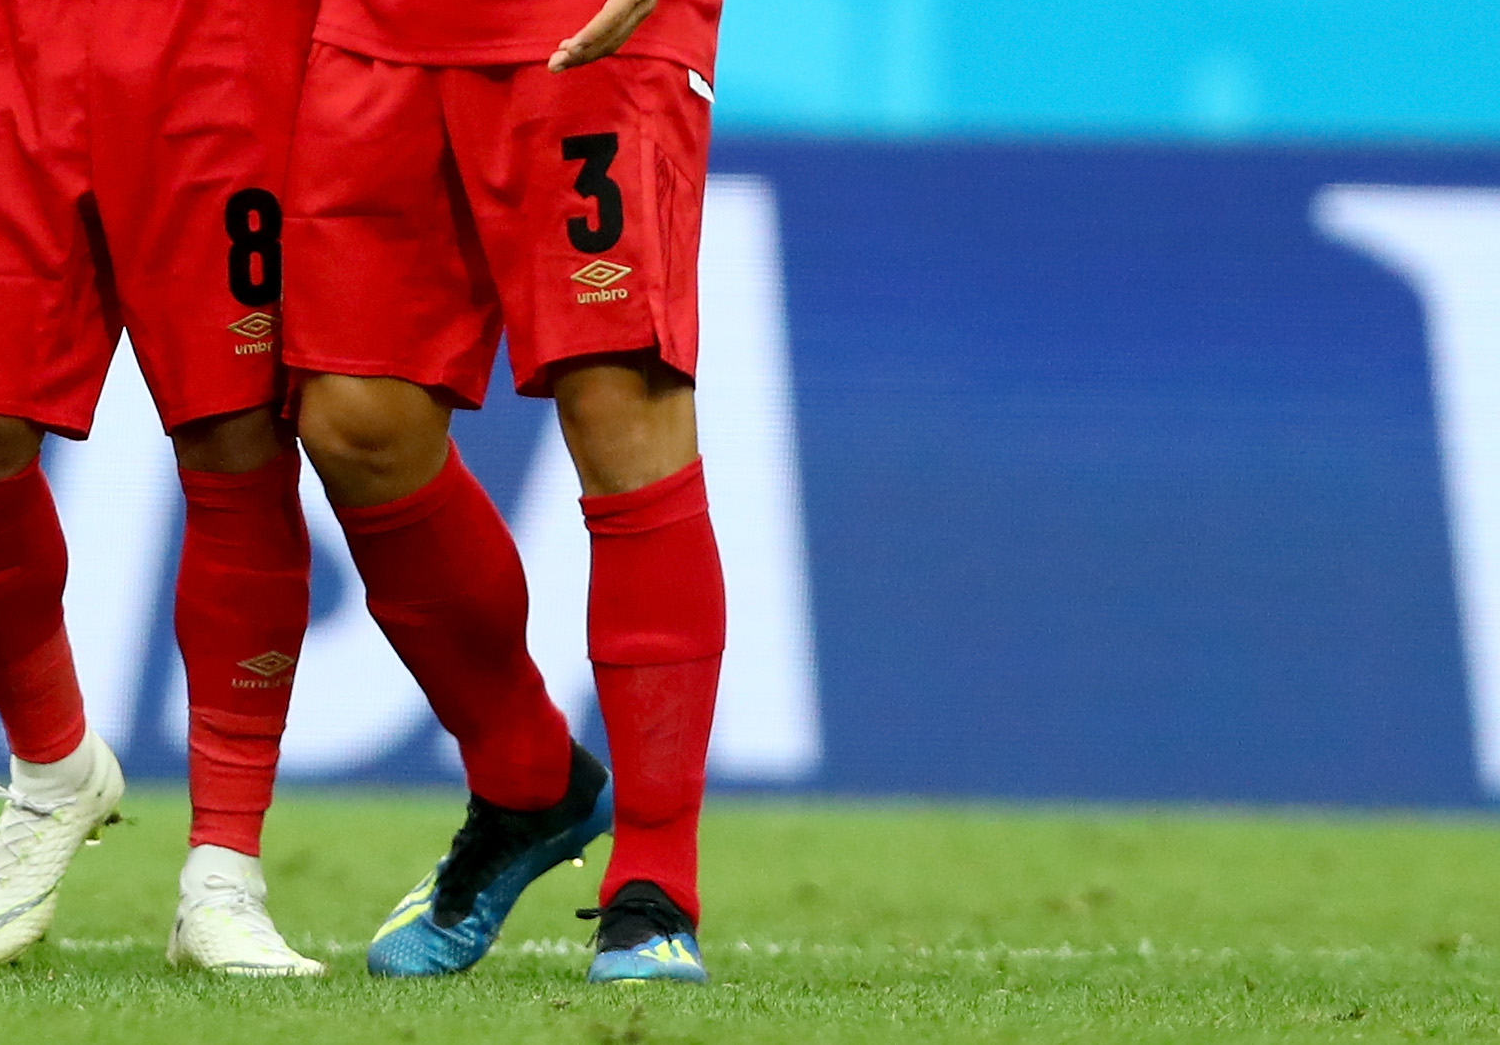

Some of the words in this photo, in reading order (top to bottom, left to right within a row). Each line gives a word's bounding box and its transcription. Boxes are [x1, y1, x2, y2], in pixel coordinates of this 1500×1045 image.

[561, 132, 624, 254] 3
[225, 187, 283, 307] 8
[577, 288, 628, 304] umbro
[235, 341, 273, 355] umbr
